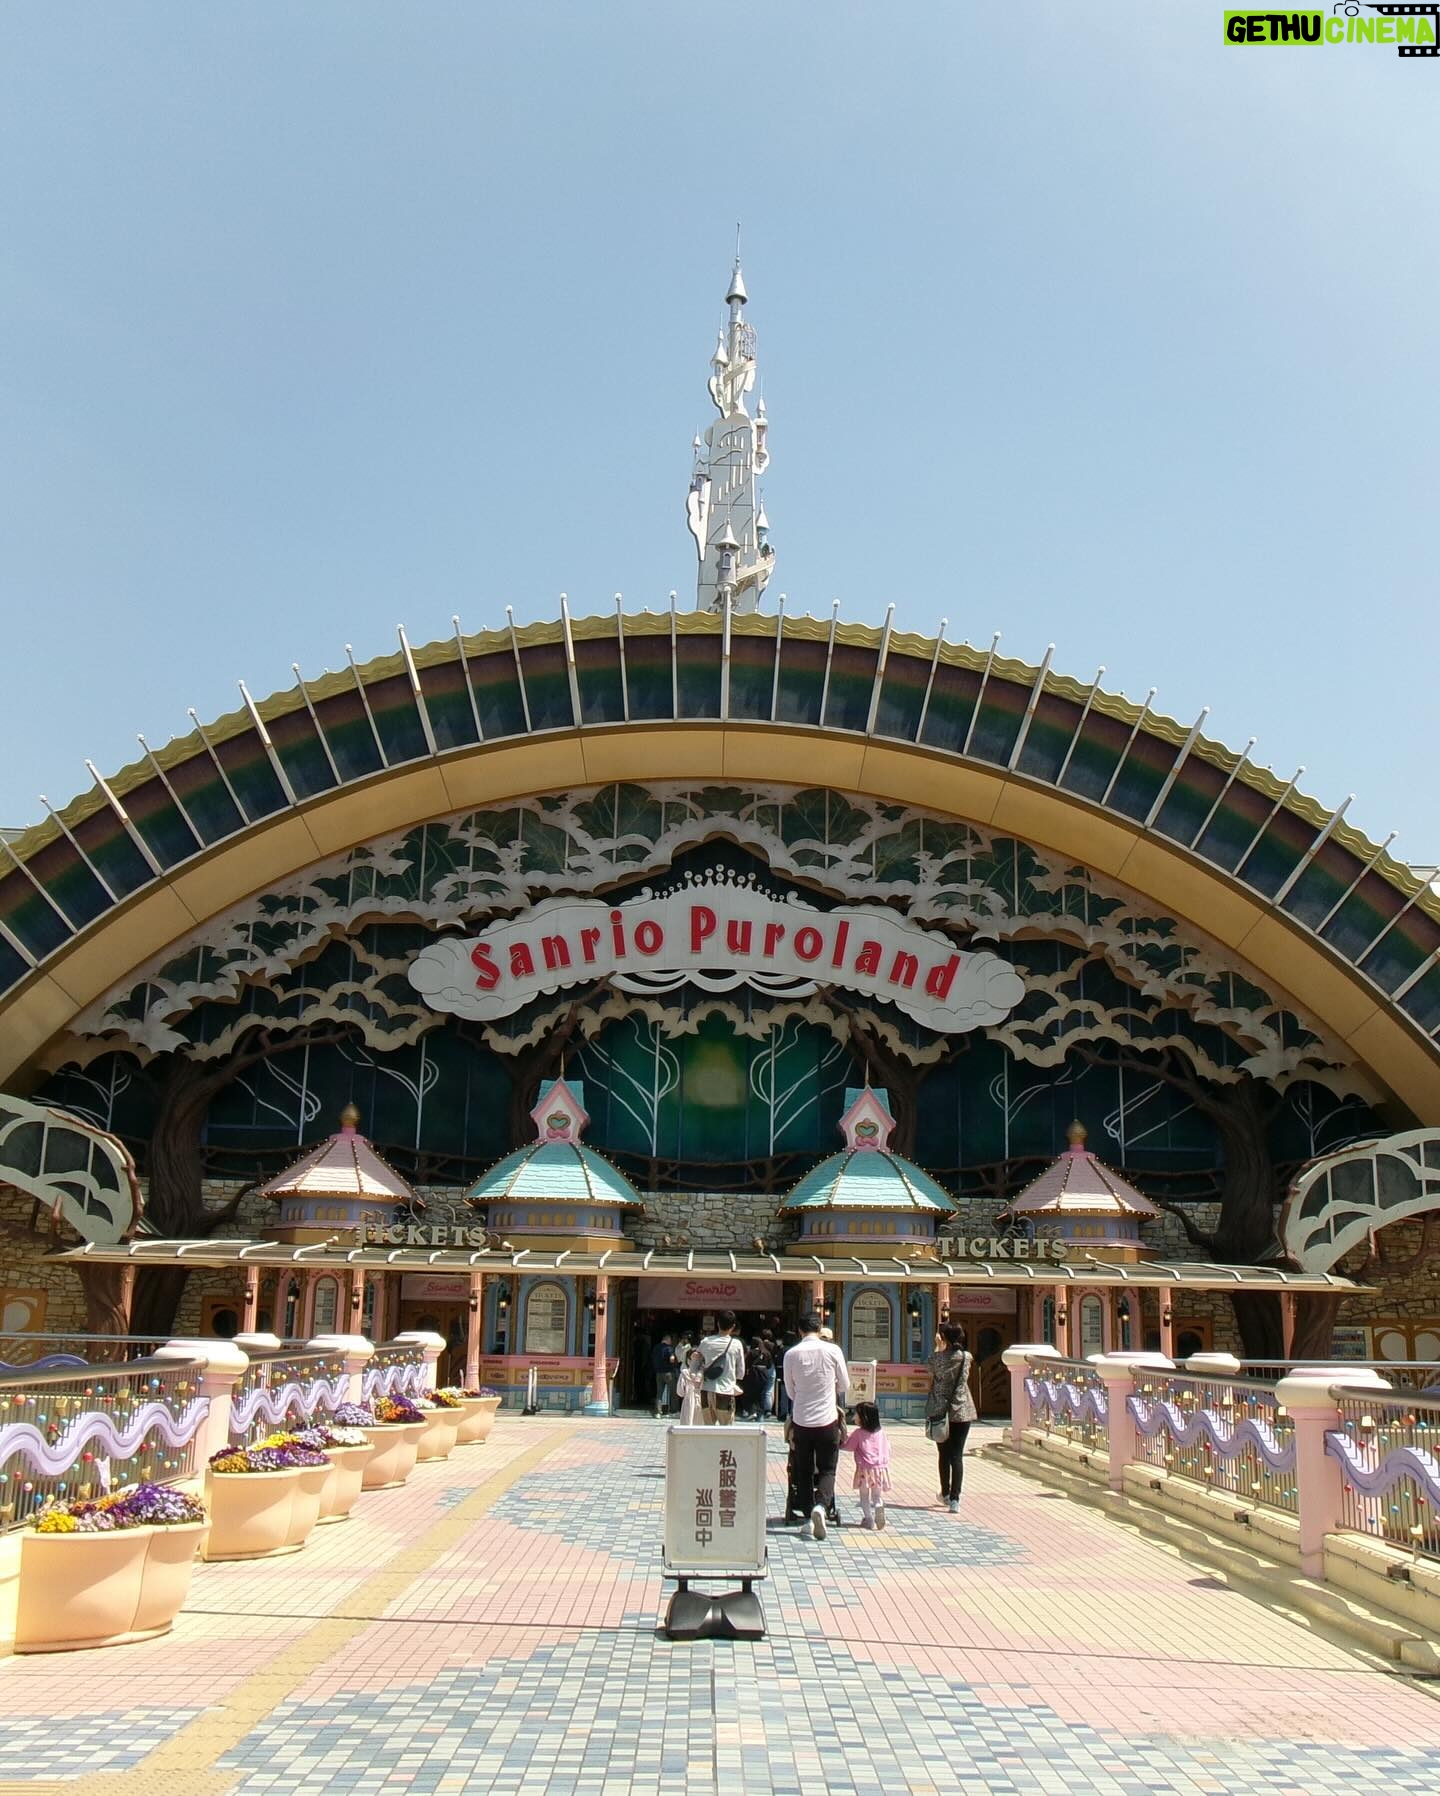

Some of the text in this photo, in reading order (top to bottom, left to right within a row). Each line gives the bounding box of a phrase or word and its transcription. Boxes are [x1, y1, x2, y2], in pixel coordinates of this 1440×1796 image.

[470, 905, 962, 1000] Sanrio Puroland
[357, 1222, 487, 1247] TICKETS
[937, 1236, 1068, 1259] TICKETS
[695, 1487, 713, 1549] 巡回中
[718, 1449, 737, 1528] 私服警官
